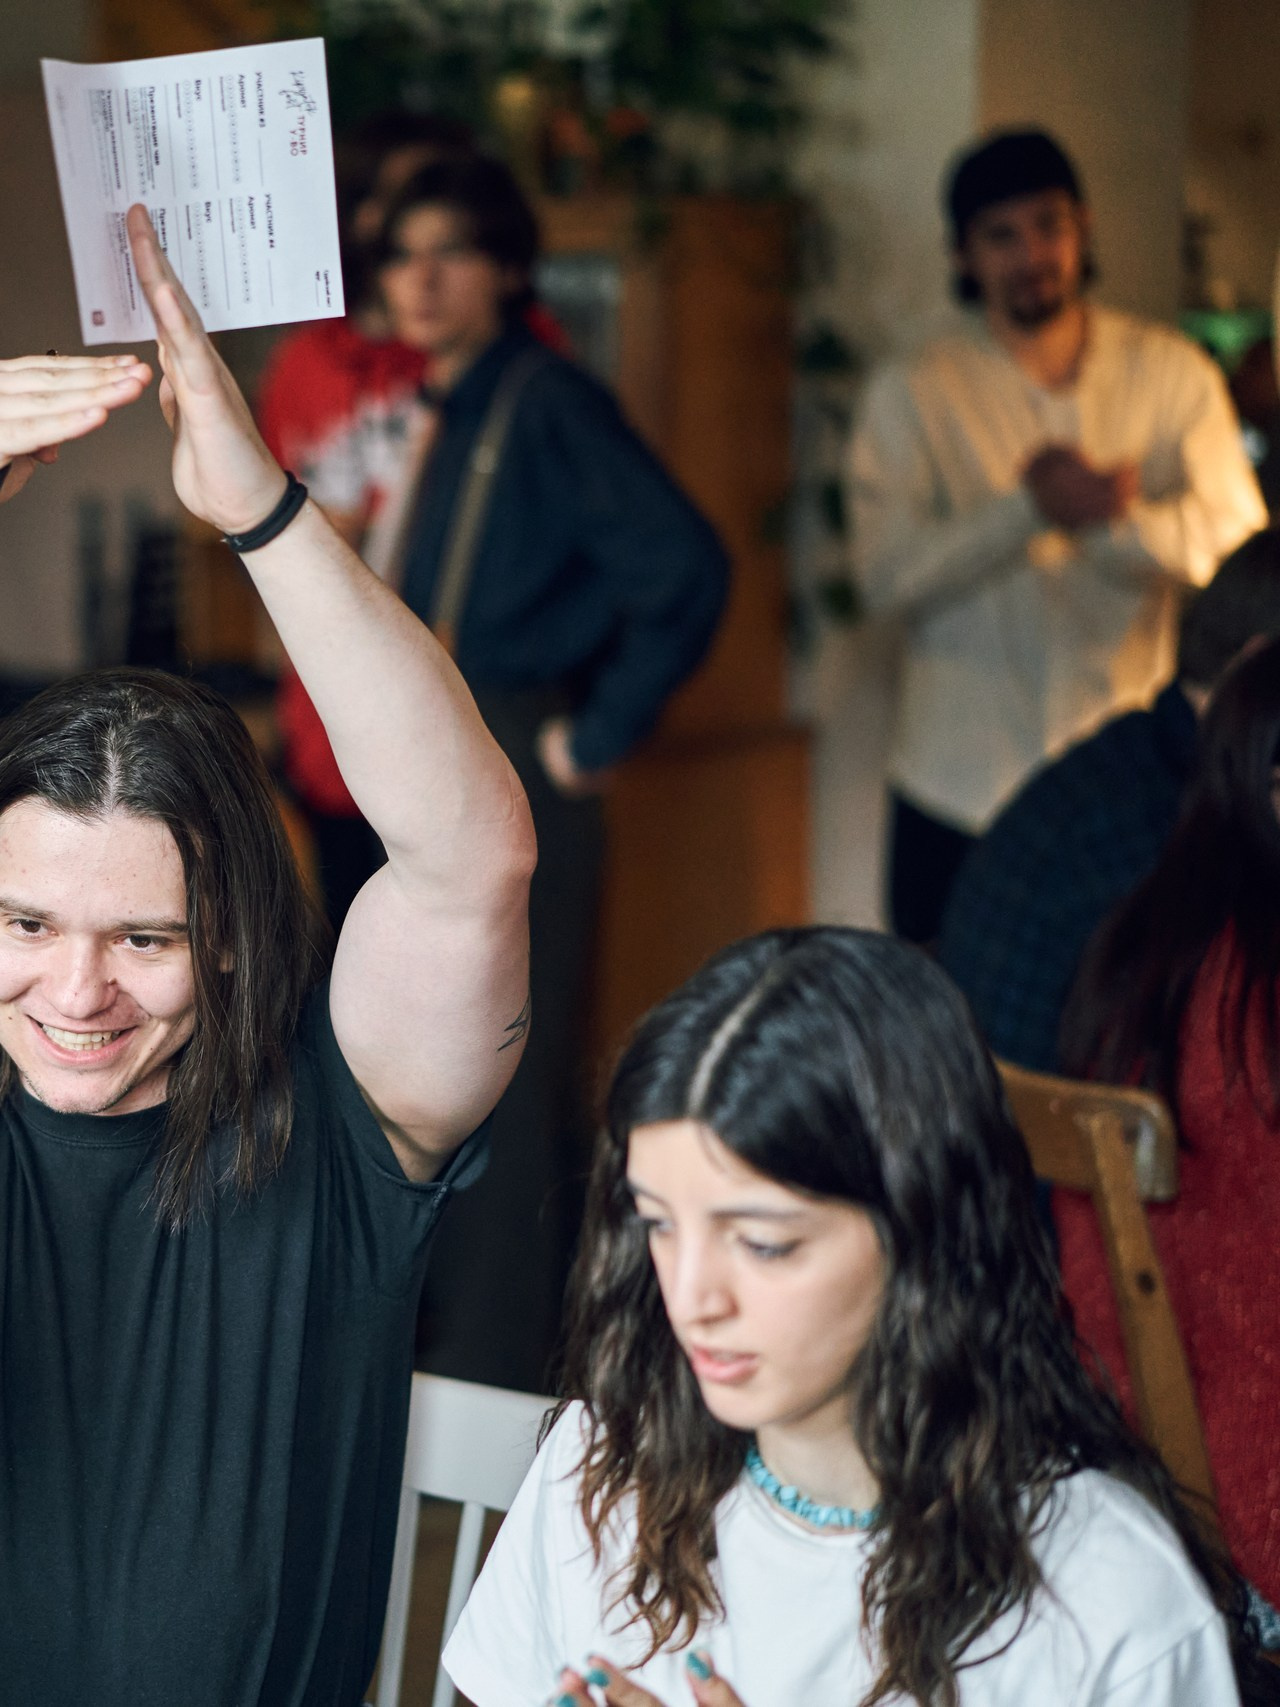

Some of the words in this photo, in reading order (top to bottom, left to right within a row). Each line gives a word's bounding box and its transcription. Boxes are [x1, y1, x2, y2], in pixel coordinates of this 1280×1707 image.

[192, 78, 202, 101] Вкус
[237, 73, 247, 108] Аромат
[255, 72, 265, 115] УЧАСТНИК
[297, 115, 308, 155] ТУРНИР
[203, 200, 212, 223] Вкус
[247, 195, 257, 230] Аромат
[263, 193, 273, 236] УЧАСТНИК
